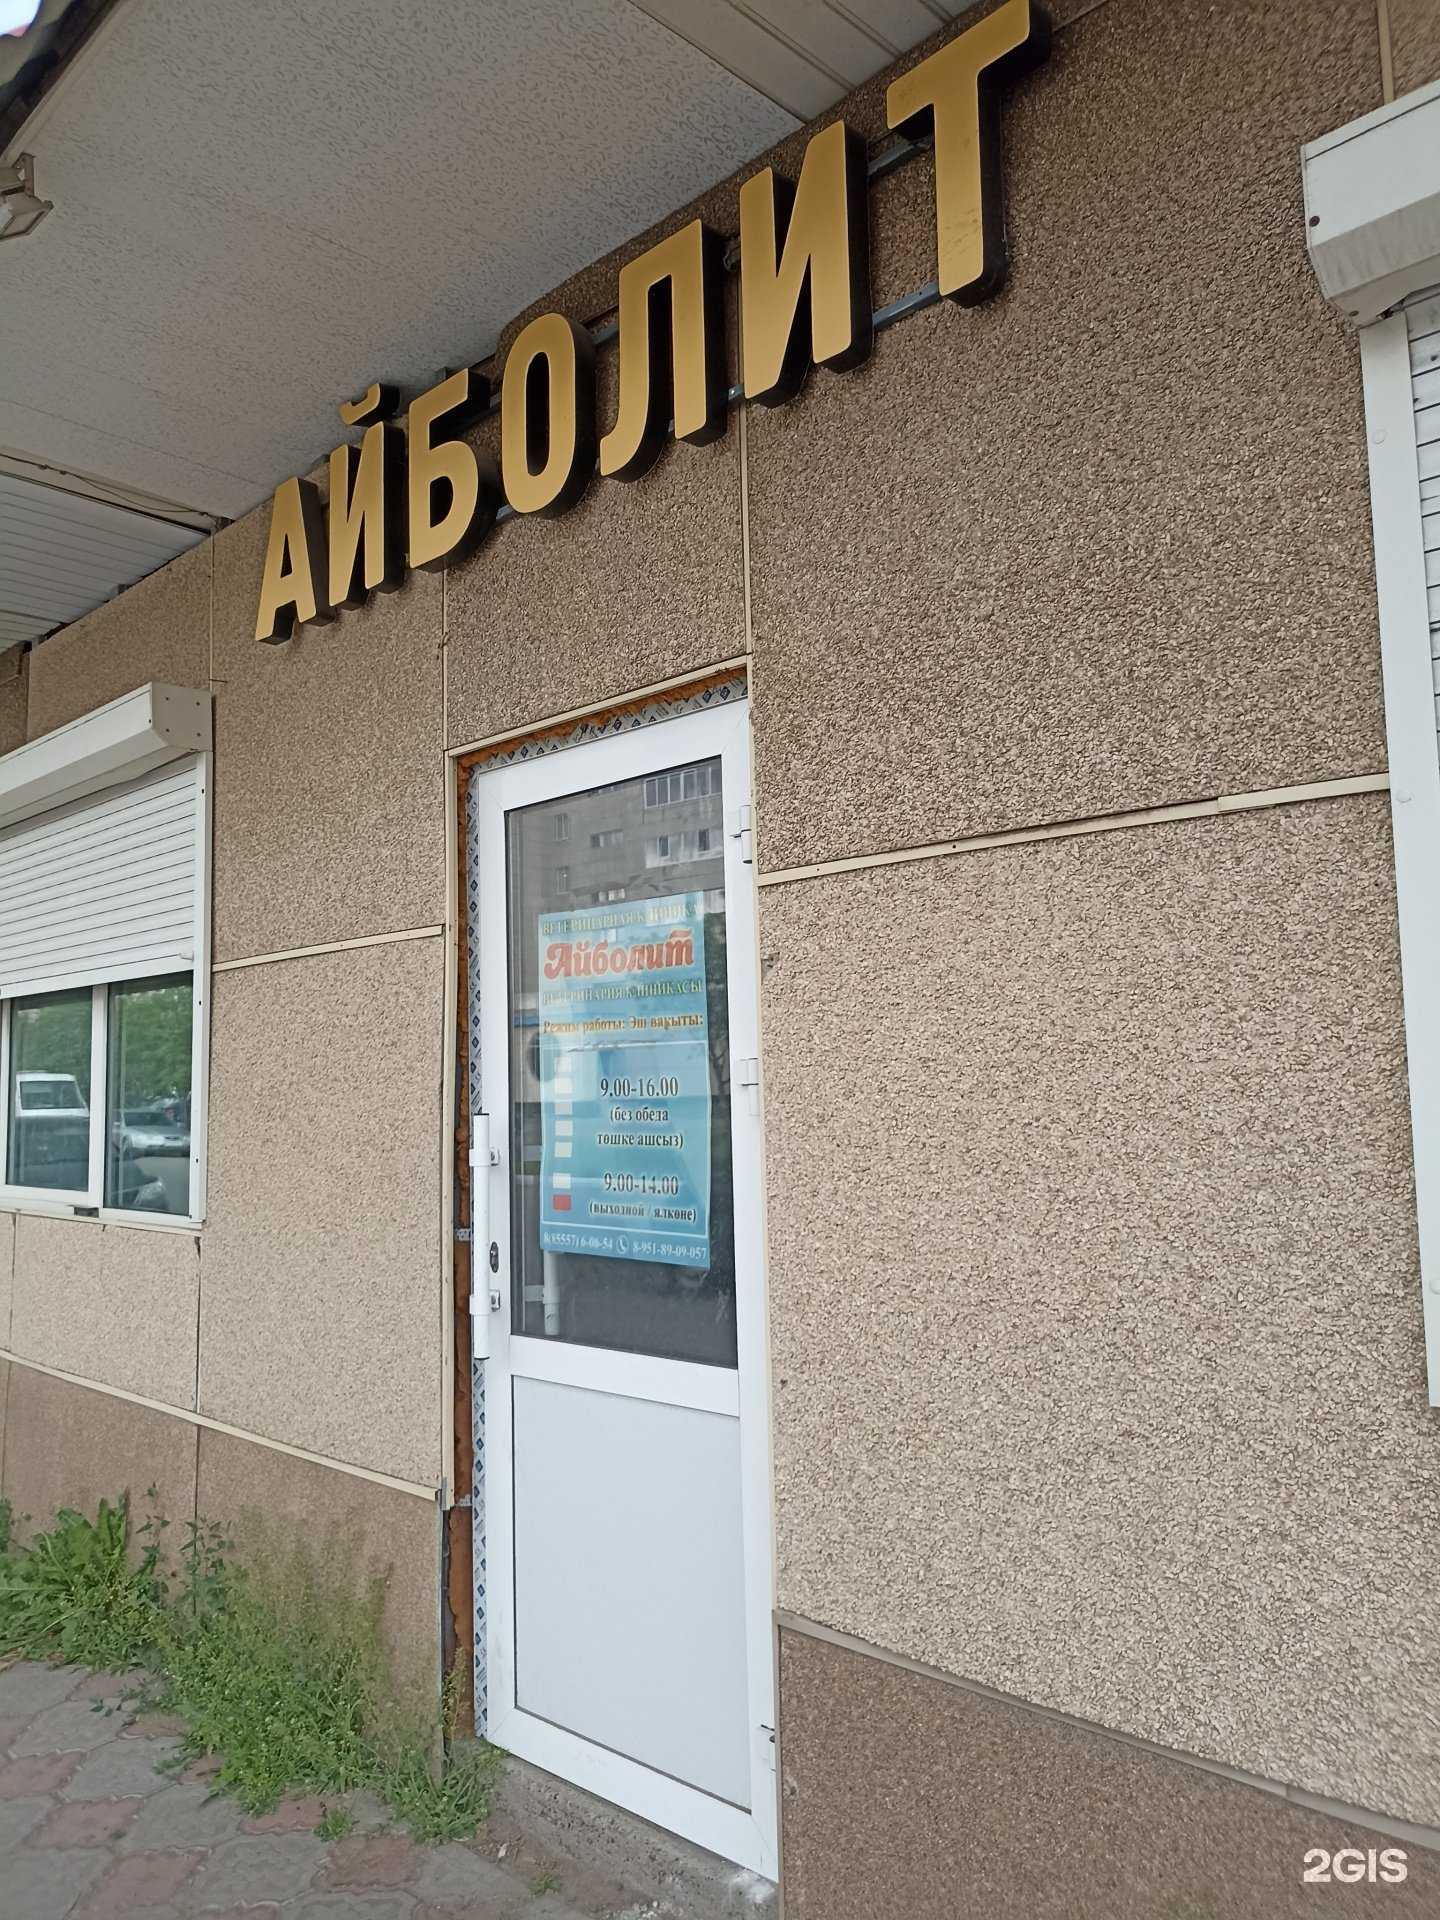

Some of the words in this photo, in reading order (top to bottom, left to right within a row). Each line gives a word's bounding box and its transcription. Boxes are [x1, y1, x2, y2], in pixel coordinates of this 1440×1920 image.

[255, 0, 1034, 645] АЙБОЛИТ
[543, 928, 695, 980] Айболит
[543, 1020, 577, 1034] Режим
[583, 1015, 625, 1034] работы:
[600, 1076, 679, 1098] 9.00-16.00
[610, 1105, 633, 1123] (без
[635, 1106, 669, 1122] обеда
[637, 1131, 684, 1149] ашсыз)
[604, 1172, 679, 1196] 9.00-14.00
[589, 1200, 645, 1218] (выходной
